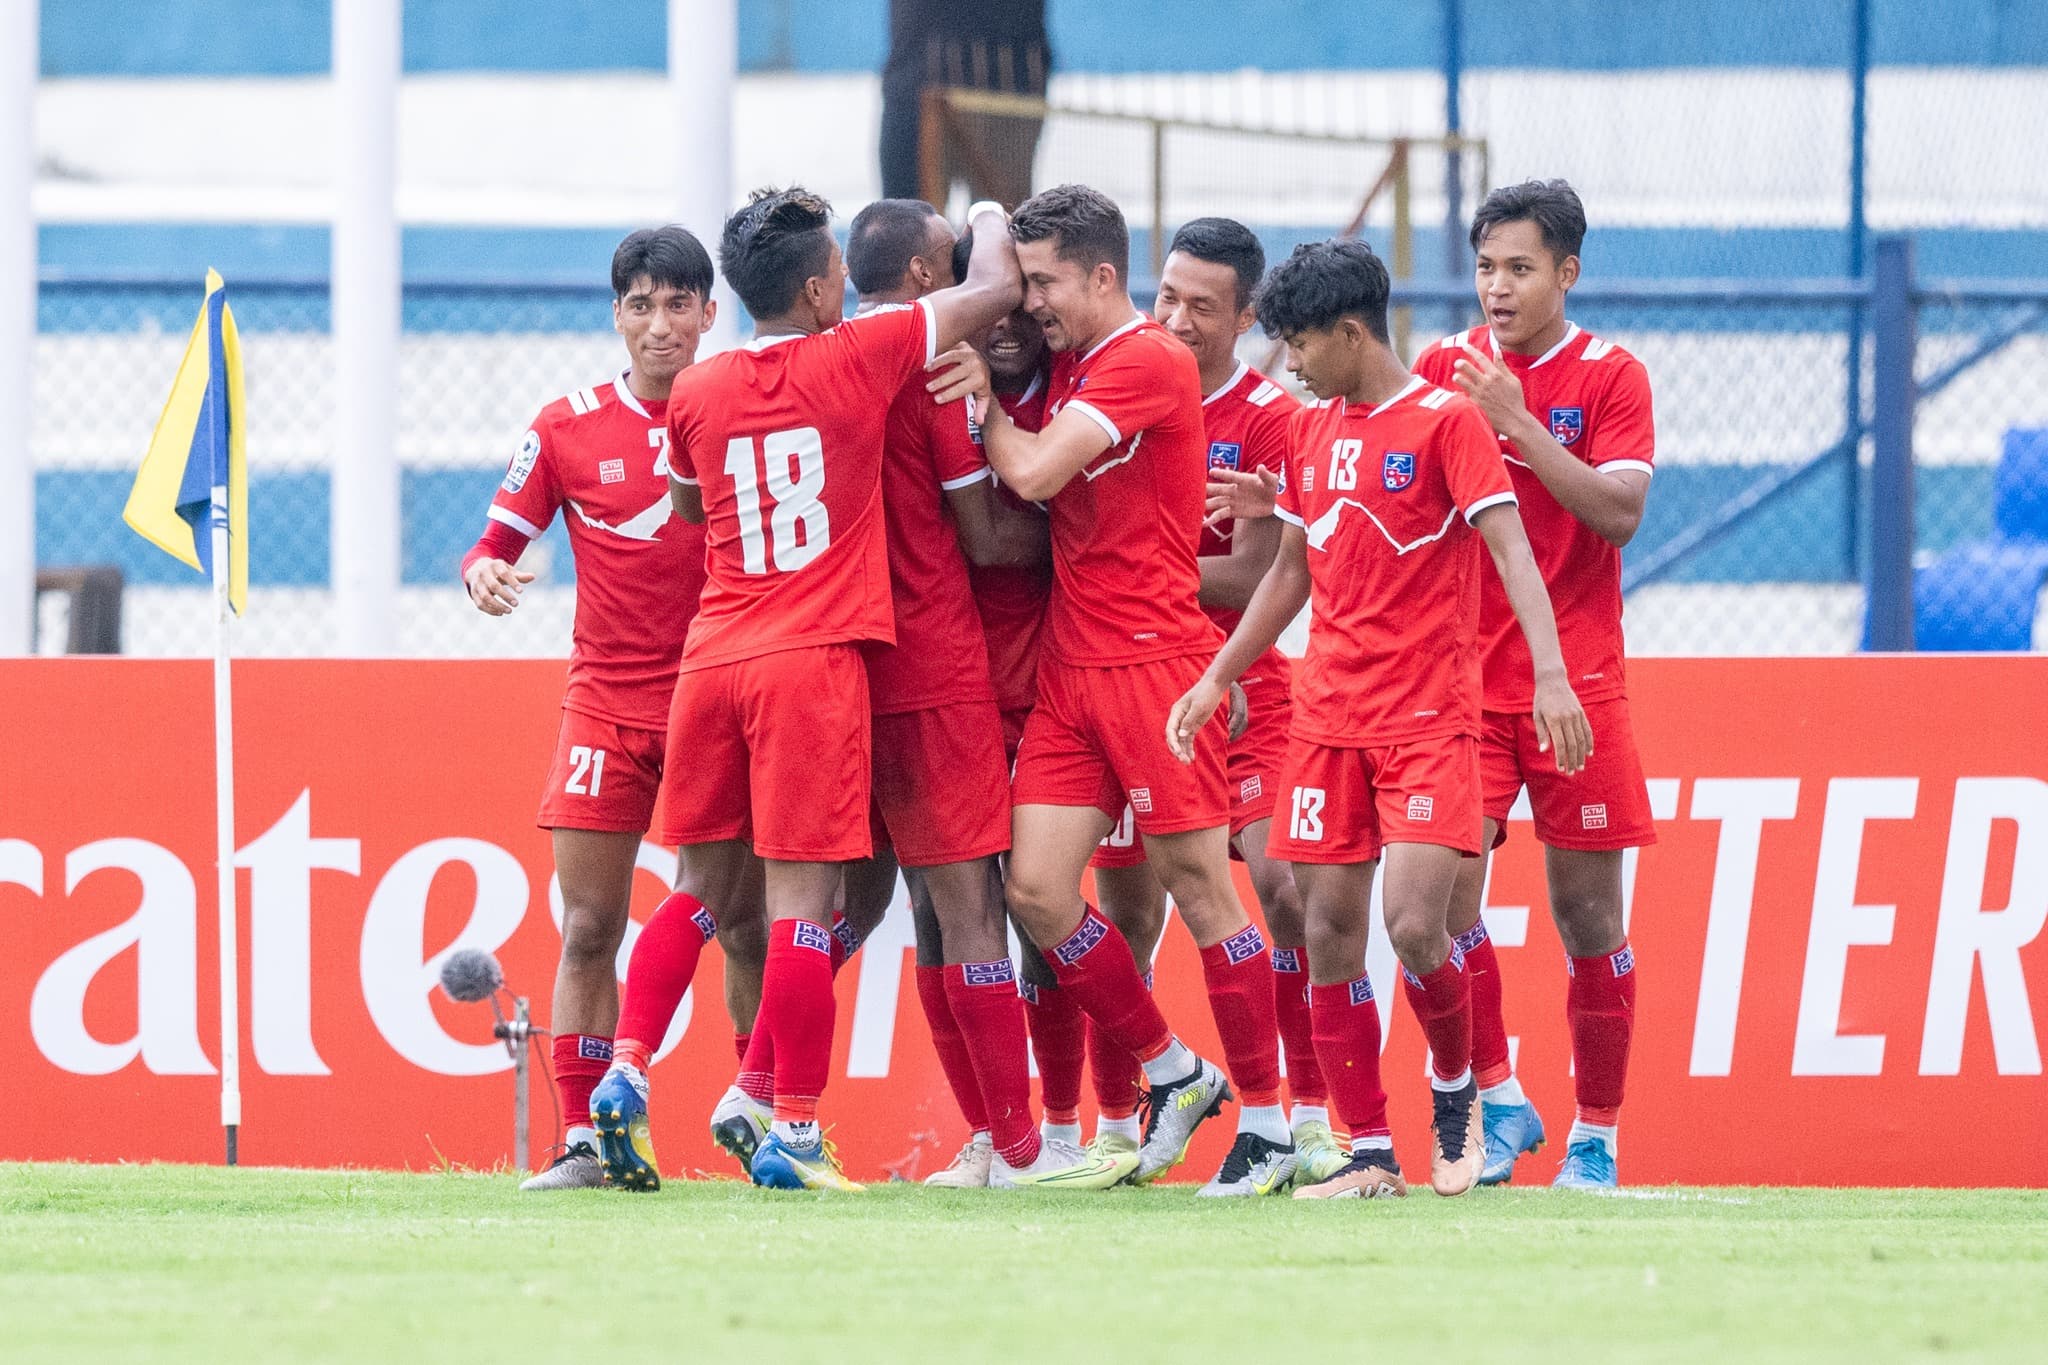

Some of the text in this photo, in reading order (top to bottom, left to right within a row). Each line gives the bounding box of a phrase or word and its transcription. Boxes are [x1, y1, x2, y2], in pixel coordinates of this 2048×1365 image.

[602, 461, 621, 470] KTM
[1327, 438, 1363, 490] 13
[604, 472, 622, 481] CTY
[723, 426, 831, 575] 18
[564, 745, 606, 797] 21
[1132, 790, 1148, 799] KTM
[1135, 801, 1150, 810] CTY
[1411, 798, 1430, 807] KTM
[1289, 786, 1325, 841] 13
[1410, 809, 1429, 818] CTY
[1584, 807, 1603, 815] KTM
[1585, 818, 1604, 826] CTY
[0, 787, 694, 1076] ate
[1061, 920, 1095, 952] KTM
[1068, 928, 1101, 960] CTY
[1236, 939, 1264, 959] CTY
[970, 962, 1009, 973] KTM
[972, 972, 1010, 983] CTY
